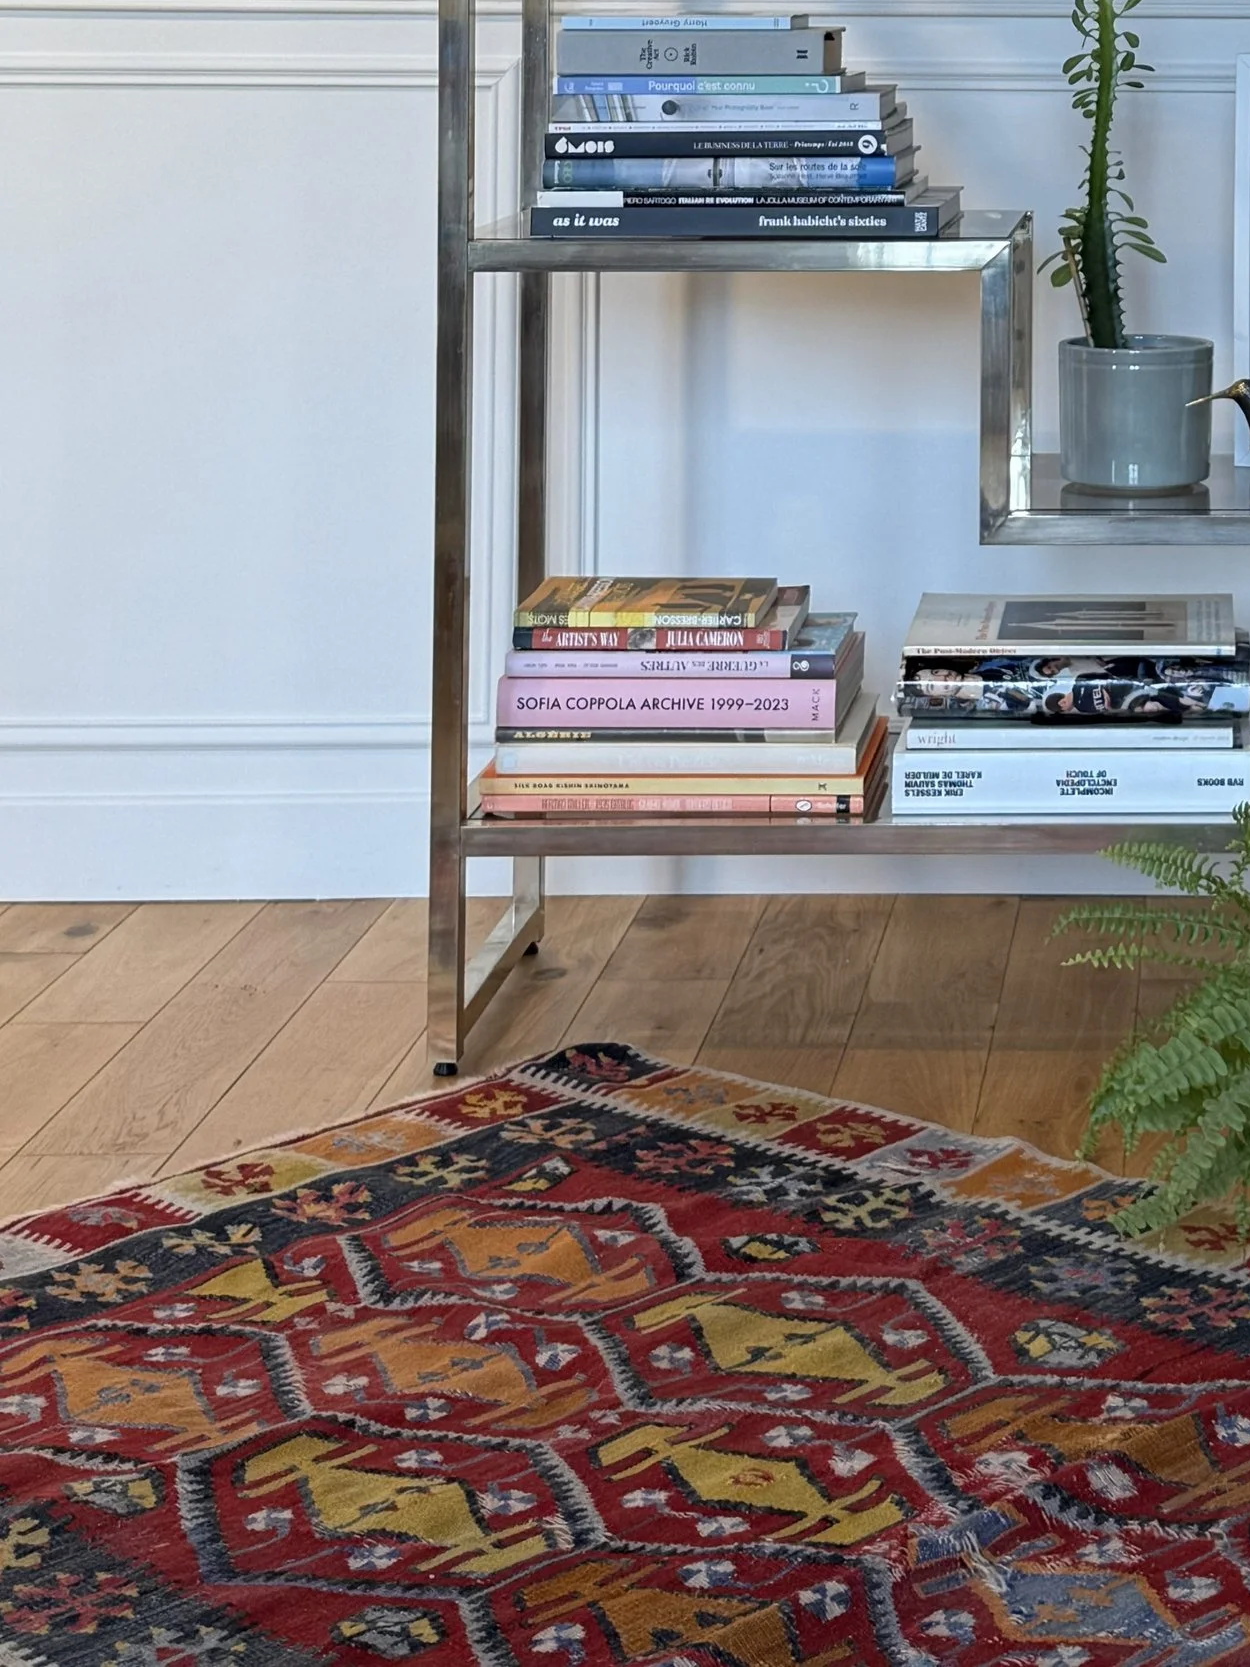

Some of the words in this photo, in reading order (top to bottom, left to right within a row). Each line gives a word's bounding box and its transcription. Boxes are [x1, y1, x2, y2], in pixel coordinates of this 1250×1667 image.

[648, 81, 695, 93] Pourquoi
[697, 81, 722, 91] c'est
[723, 82, 755, 91] connu
[752, 141, 763, 149] LA
[764, 141, 788, 149] TERRE
[769, 162, 784, 171] Sur
[786, 162, 797, 171] les
[800, 162, 825, 171] routes
[827, 162, 838, 171] de
[840, 162, 848, 171] la
[716, 196, 754, 204] EVOLUTION
[787, 196, 817, 204] MUSEUM
[553, 216, 570, 227] as
[574, 213, 586, 227] it
[589, 216, 620, 227] was
[758, 215, 791, 227] frank
[793, 215, 846, 227] habicht's
[848, 215, 887, 227] sixties
[555, 631, 598, 647] ARTIST'S
[599, 631, 620, 647] WAY
[665, 630, 693, 646] JULIA
[695, 630, 744, 647] CAMERON
[640, 660, 689, 672] AUTRES
[706, 660, 758, 672] GUERRE
[516, 696, 562, 711] SOFIA
[566, 696, 637, 711] COPPOLA
[640, 696, 705, 711] ARCHIVE
[811, 688, 821, 722] MACK
[917, 732, 957, 746] wright
[904, 771, 940, 779] MULDER
[941, 771, 953, 779] DE
[954, 771, 983, 779] KAREL
[1066, 770, 1094, 778] TOUCH
[1096, 770, 1107, 778] OF
[904, 780, 936, 788] SAUVIN
[937, 780, 974, 788] THOMAS
[1056, 779, 1118, 787] ENCYCLOPEDIA
[1197, 778, 1225, 786] BOOKS
[1227, 778, 1244, 786] RVB
[904, 788, 942, 796] KESSELS
[944, 788, 964, 796] ERIK
[1060, 787, 1114, 795] INCOMPLETE
